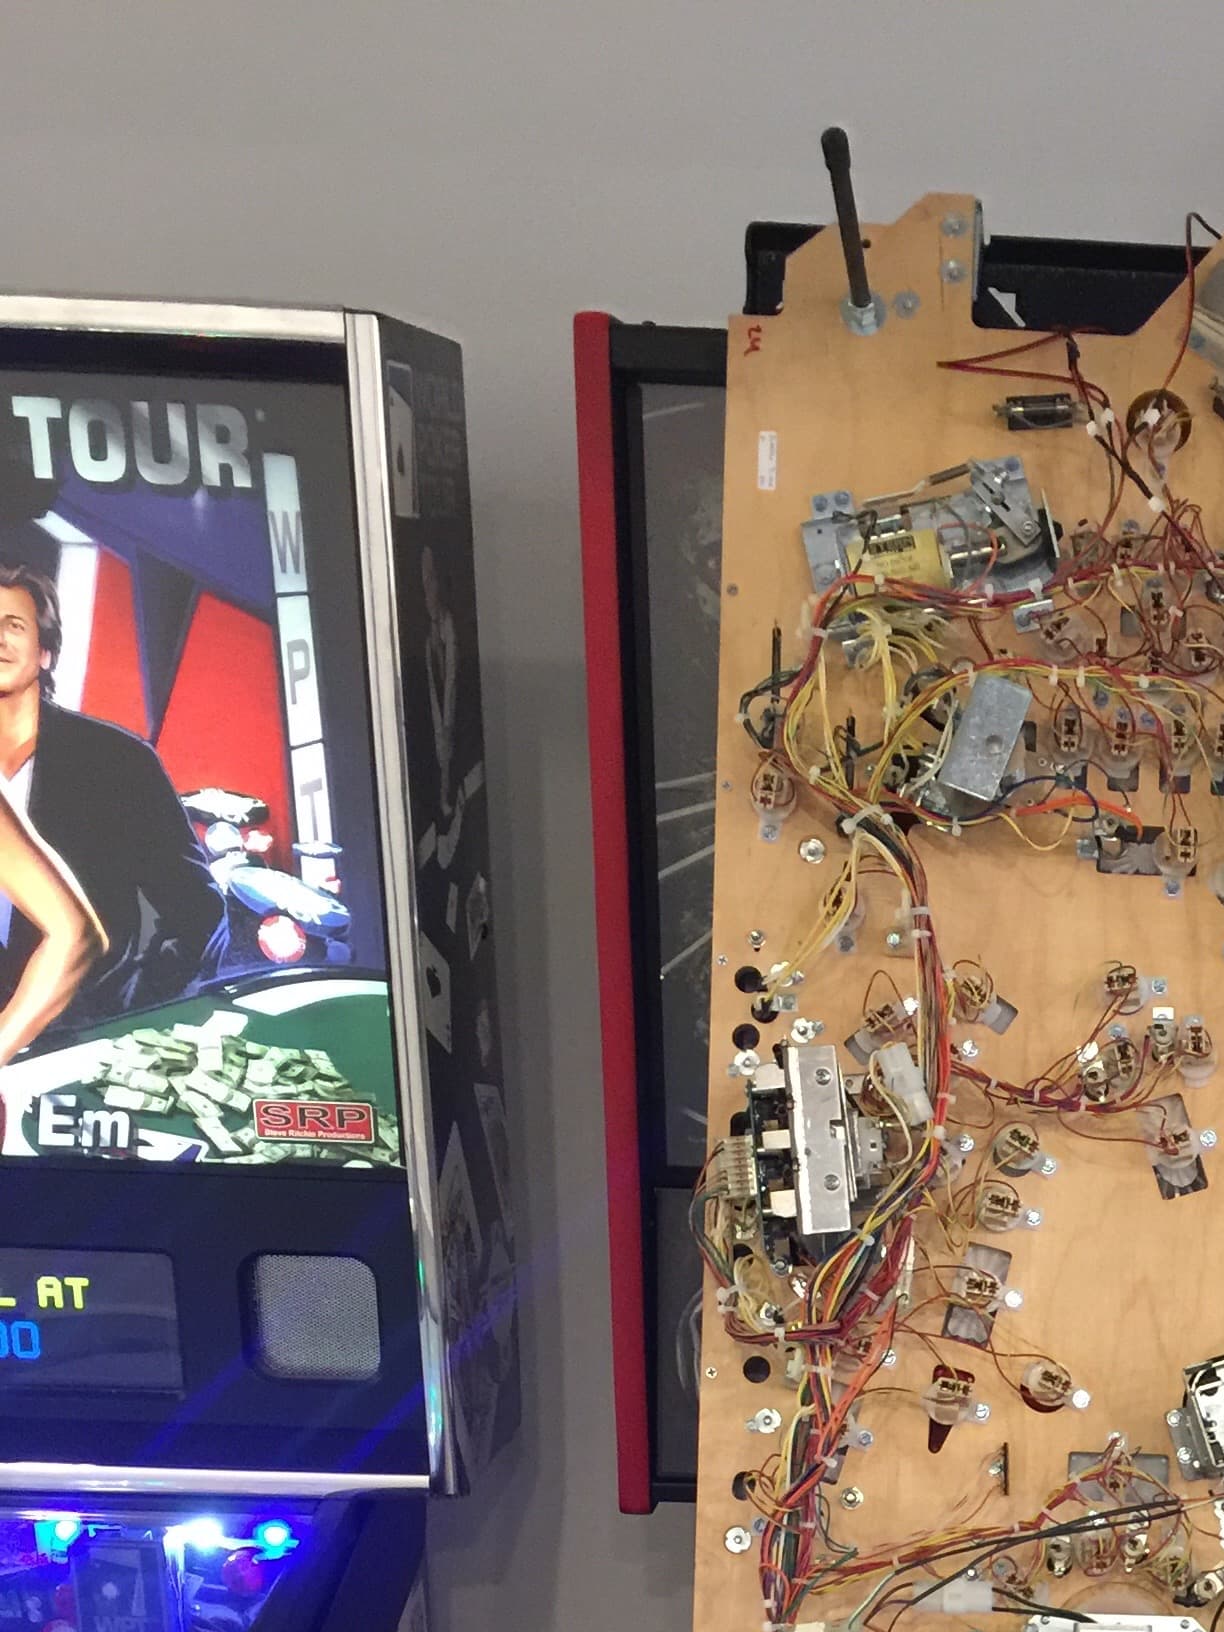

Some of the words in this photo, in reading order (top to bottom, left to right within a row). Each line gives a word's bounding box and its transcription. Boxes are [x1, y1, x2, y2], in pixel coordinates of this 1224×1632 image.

[11, 394, 254, 489] TOUR
[260, 1103, 368, 1130] SRP
[37, 1275, 90, 1310] AT
